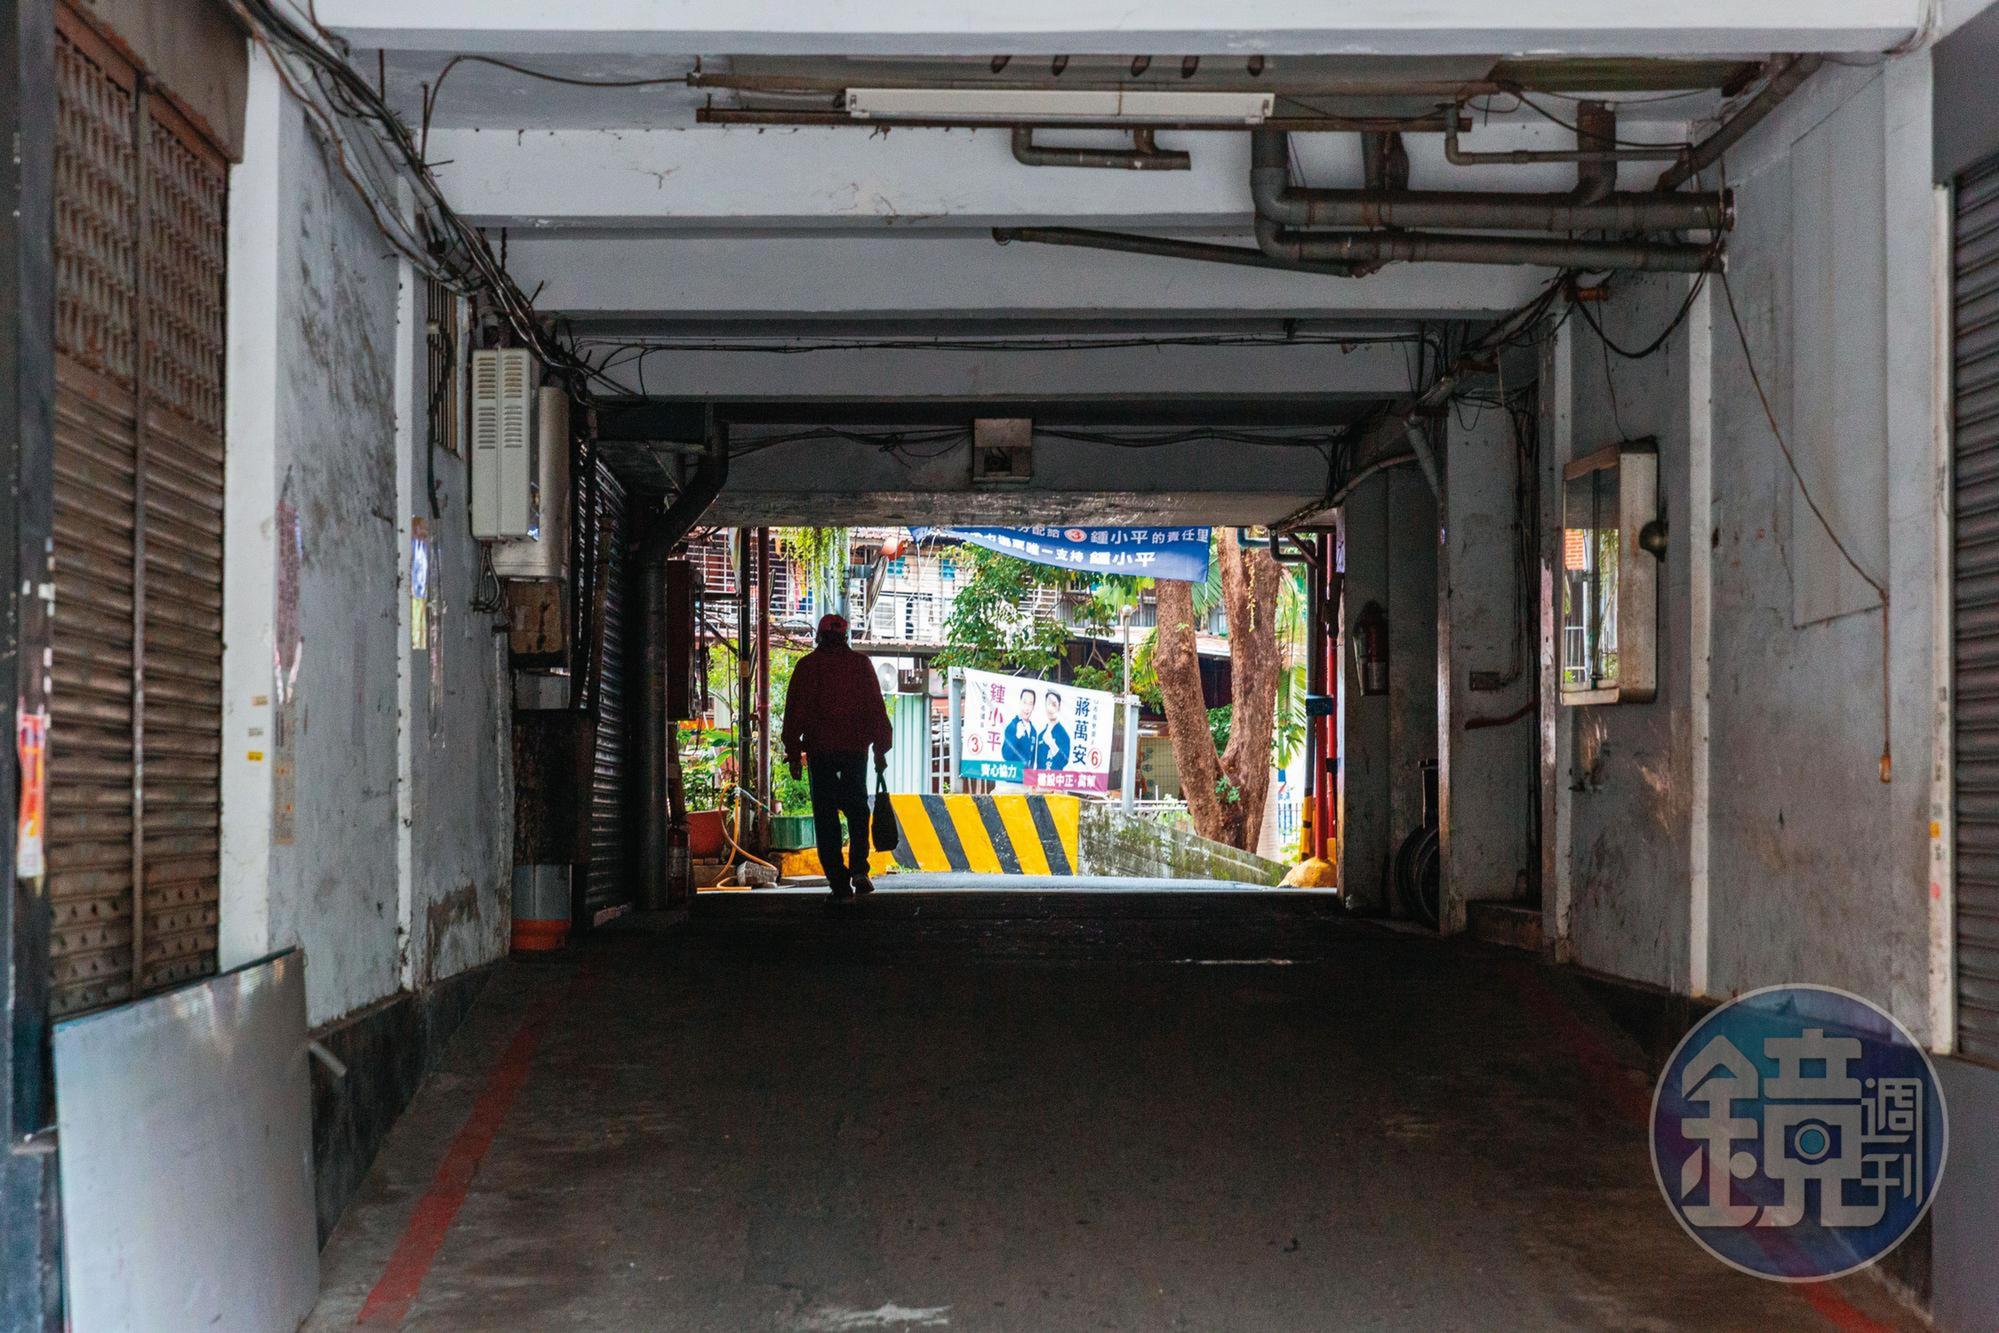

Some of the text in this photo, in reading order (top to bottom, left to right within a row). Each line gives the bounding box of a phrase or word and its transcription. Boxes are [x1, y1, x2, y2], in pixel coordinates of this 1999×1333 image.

[987, 683, 1006, 752] 鍾小平
[1072, 696, 1091, 765] 蔣萬安
